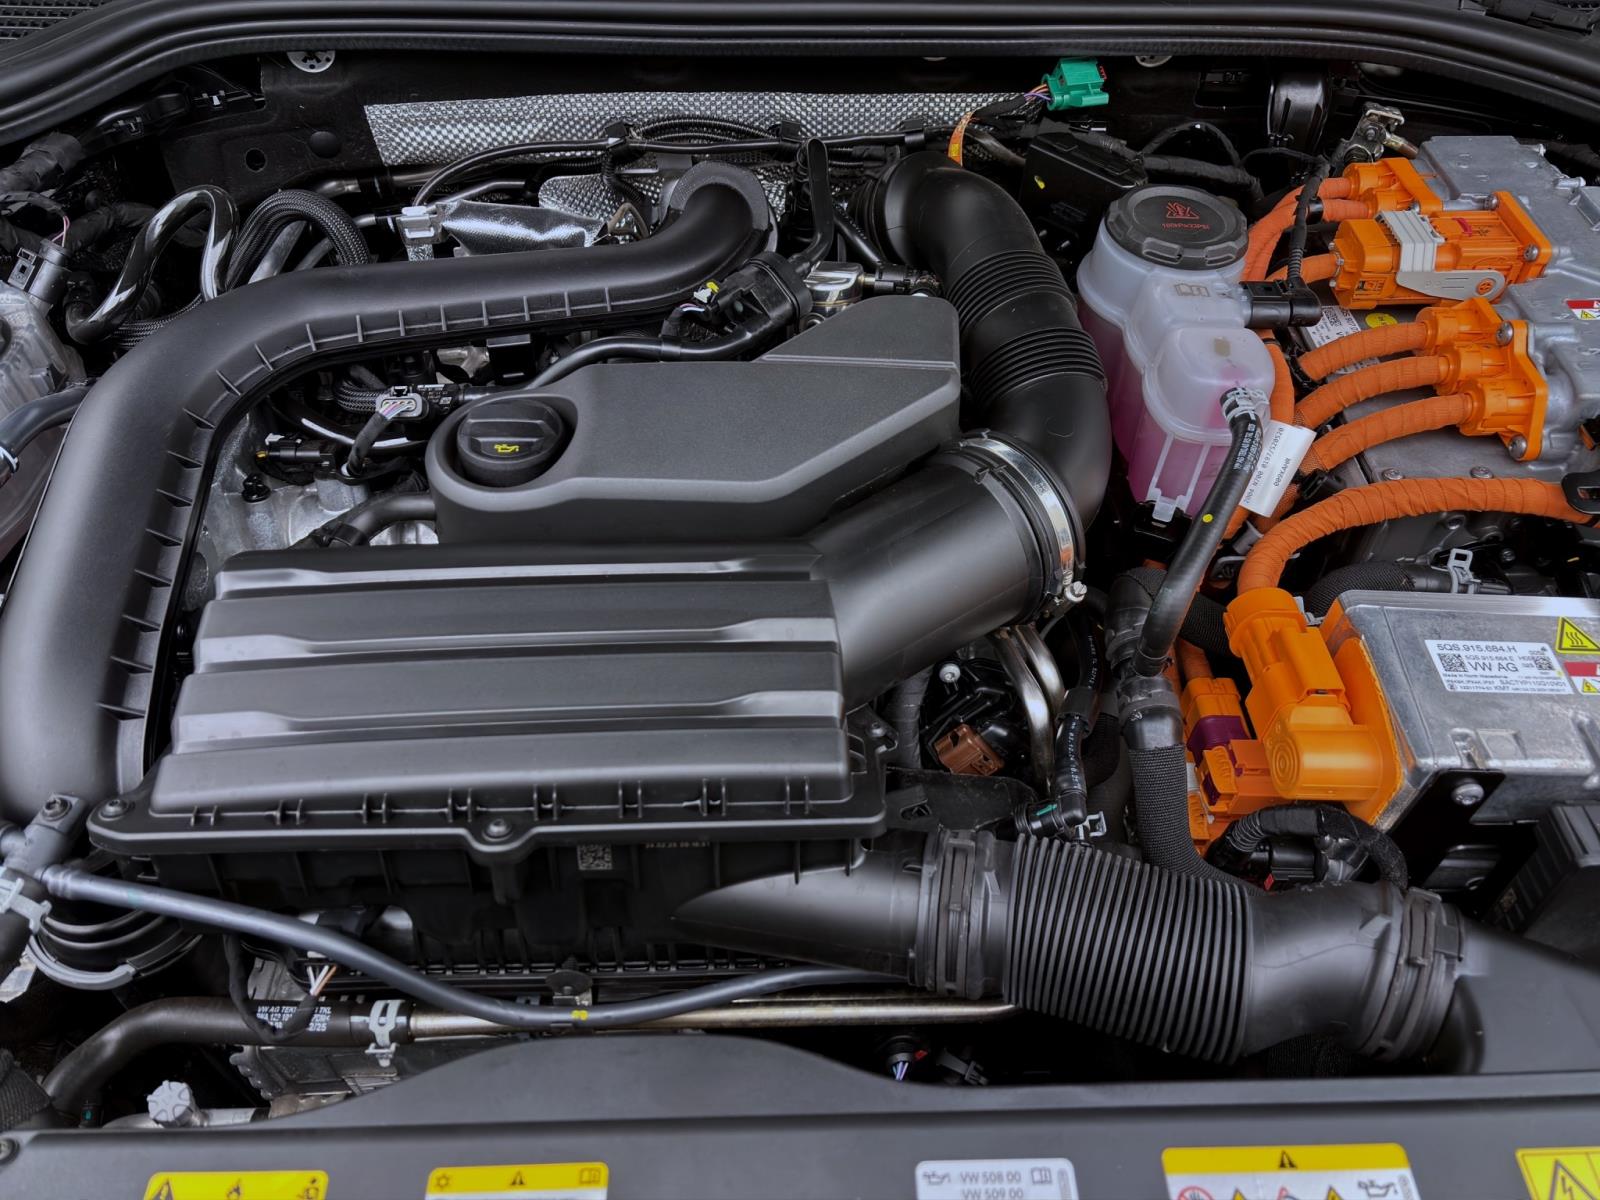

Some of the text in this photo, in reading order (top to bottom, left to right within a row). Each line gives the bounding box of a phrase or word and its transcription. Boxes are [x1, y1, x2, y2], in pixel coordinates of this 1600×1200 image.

[1467, 662, 1492, 671] VW
[1498, 662, 1519, 672] AG
[960, 1172, 979, 1183] VW
[1006, 1171, 1022, 1183] 00
